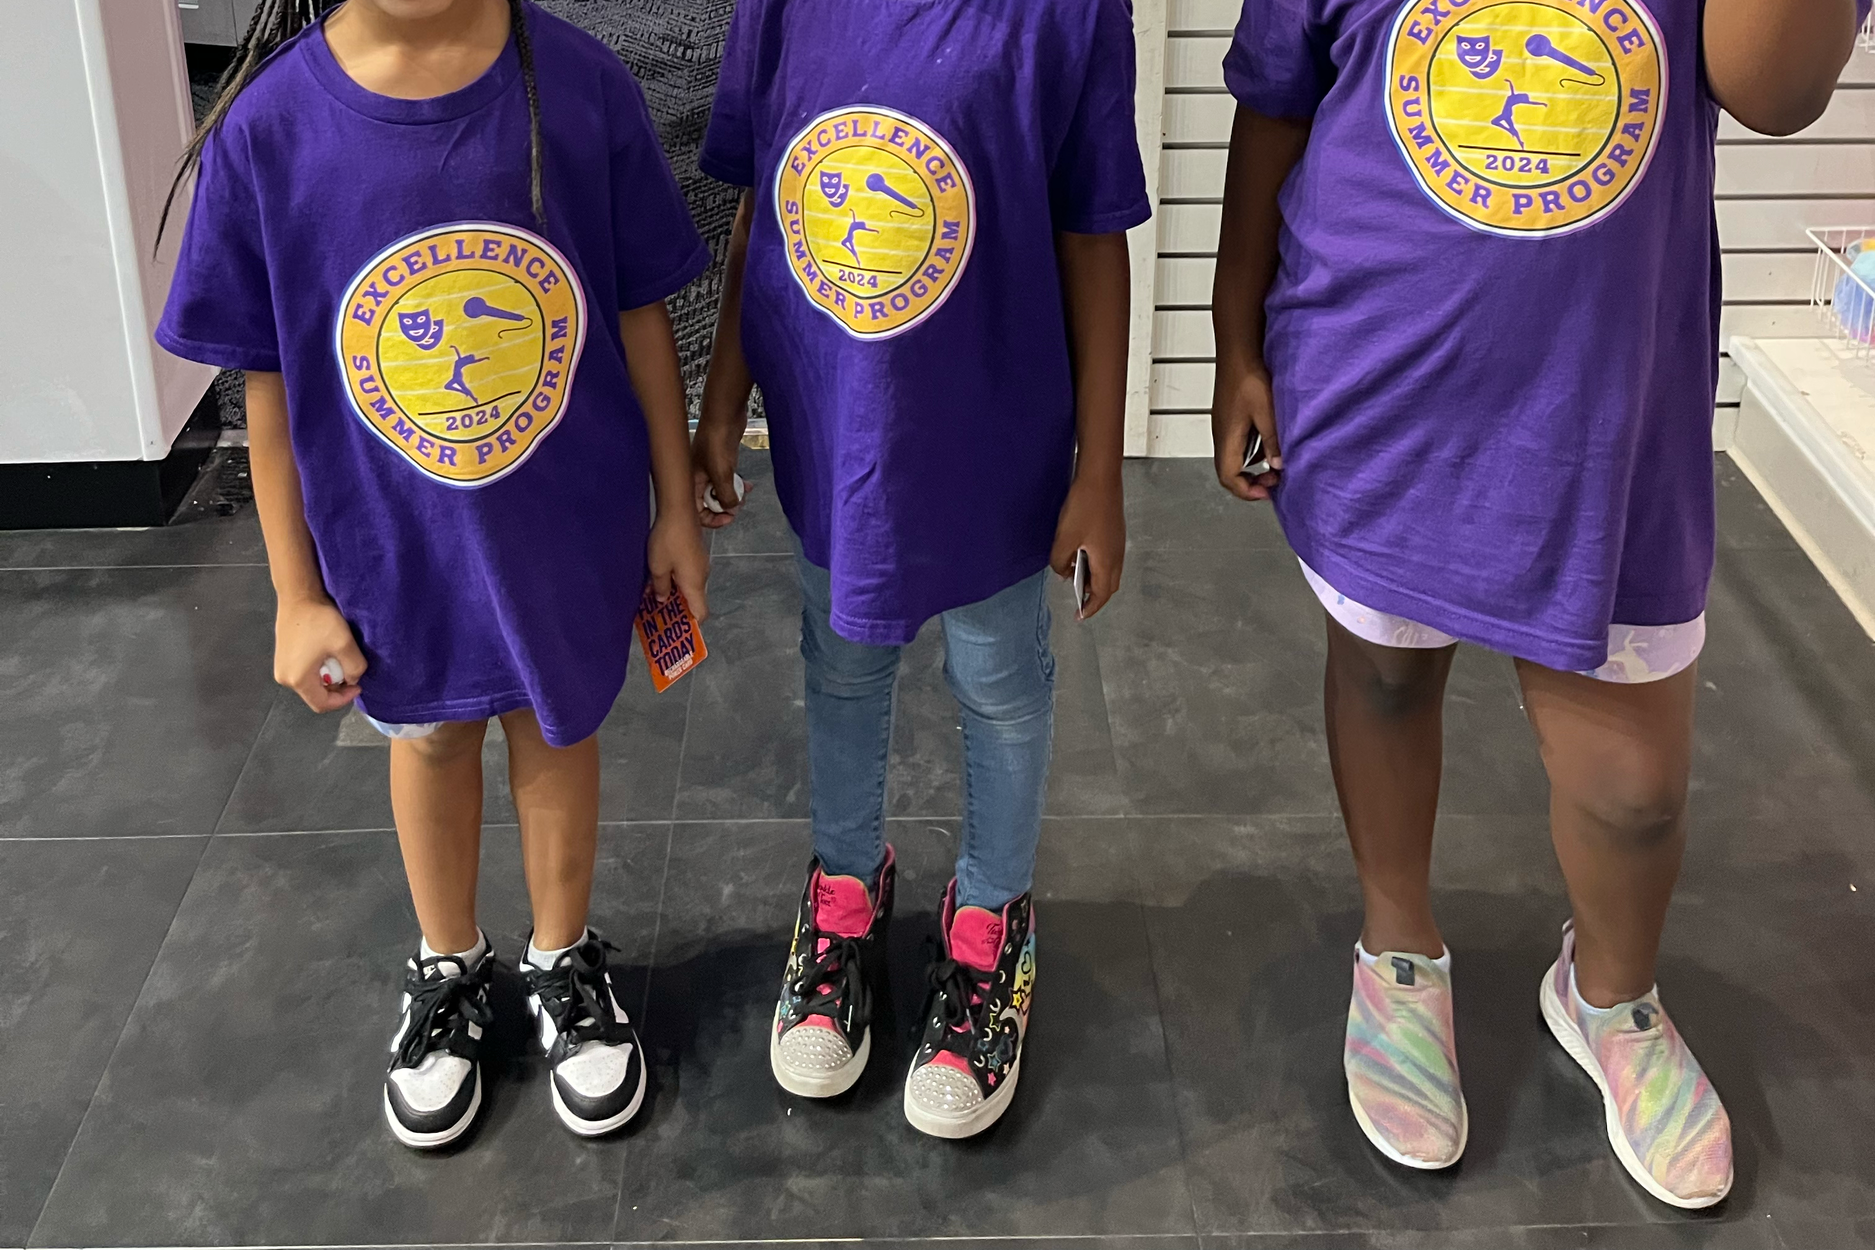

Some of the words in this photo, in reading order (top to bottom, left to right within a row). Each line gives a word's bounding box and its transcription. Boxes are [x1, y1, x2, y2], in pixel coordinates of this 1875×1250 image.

[791, 119, 957, 193] EXCELLENCE
[1399, 74, 1493, 209] SUMMER
[1512, 87, 1651, 215] PROGRAM
[1485, 154, 1550, 174] 2024
[785, 200, 846, 310] SUMMER
[854, 220, 961, 320] PROGRAM
[838, 269, 878, 288] 2024
[352, 239, 560, 326] EXCELLENCE
[352, 354, 457, 466] SUMMER
[475, 316, 568, 464] PROGRAM
[445, 405, 501, 431] 2024
[643, 616, 658, 639] IN
[657, 596, 685, 626] THE
[648, 615, 691, 658] CARDS
[655, 633, 695, 676] TODAY
